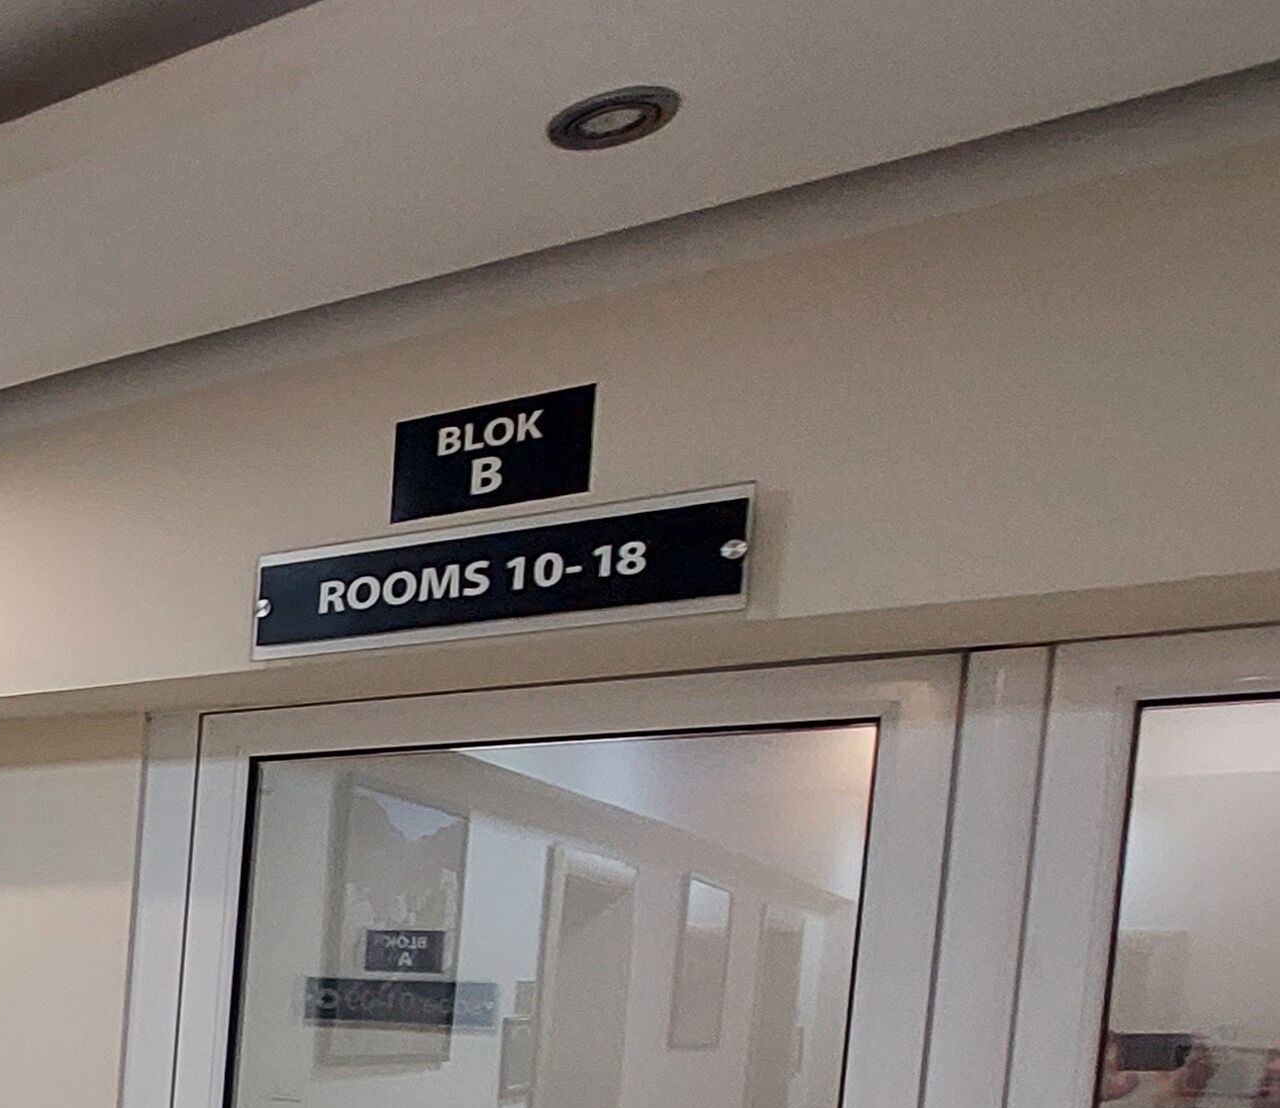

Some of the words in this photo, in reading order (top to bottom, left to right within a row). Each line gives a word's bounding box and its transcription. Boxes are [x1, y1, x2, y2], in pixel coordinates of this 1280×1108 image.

[437, 409, 543, 456] BLOK
[470, 456, 502, 495] B
[318, 560, 490, 614] ROOMS
[506, 541, 646, 590] 10-18
